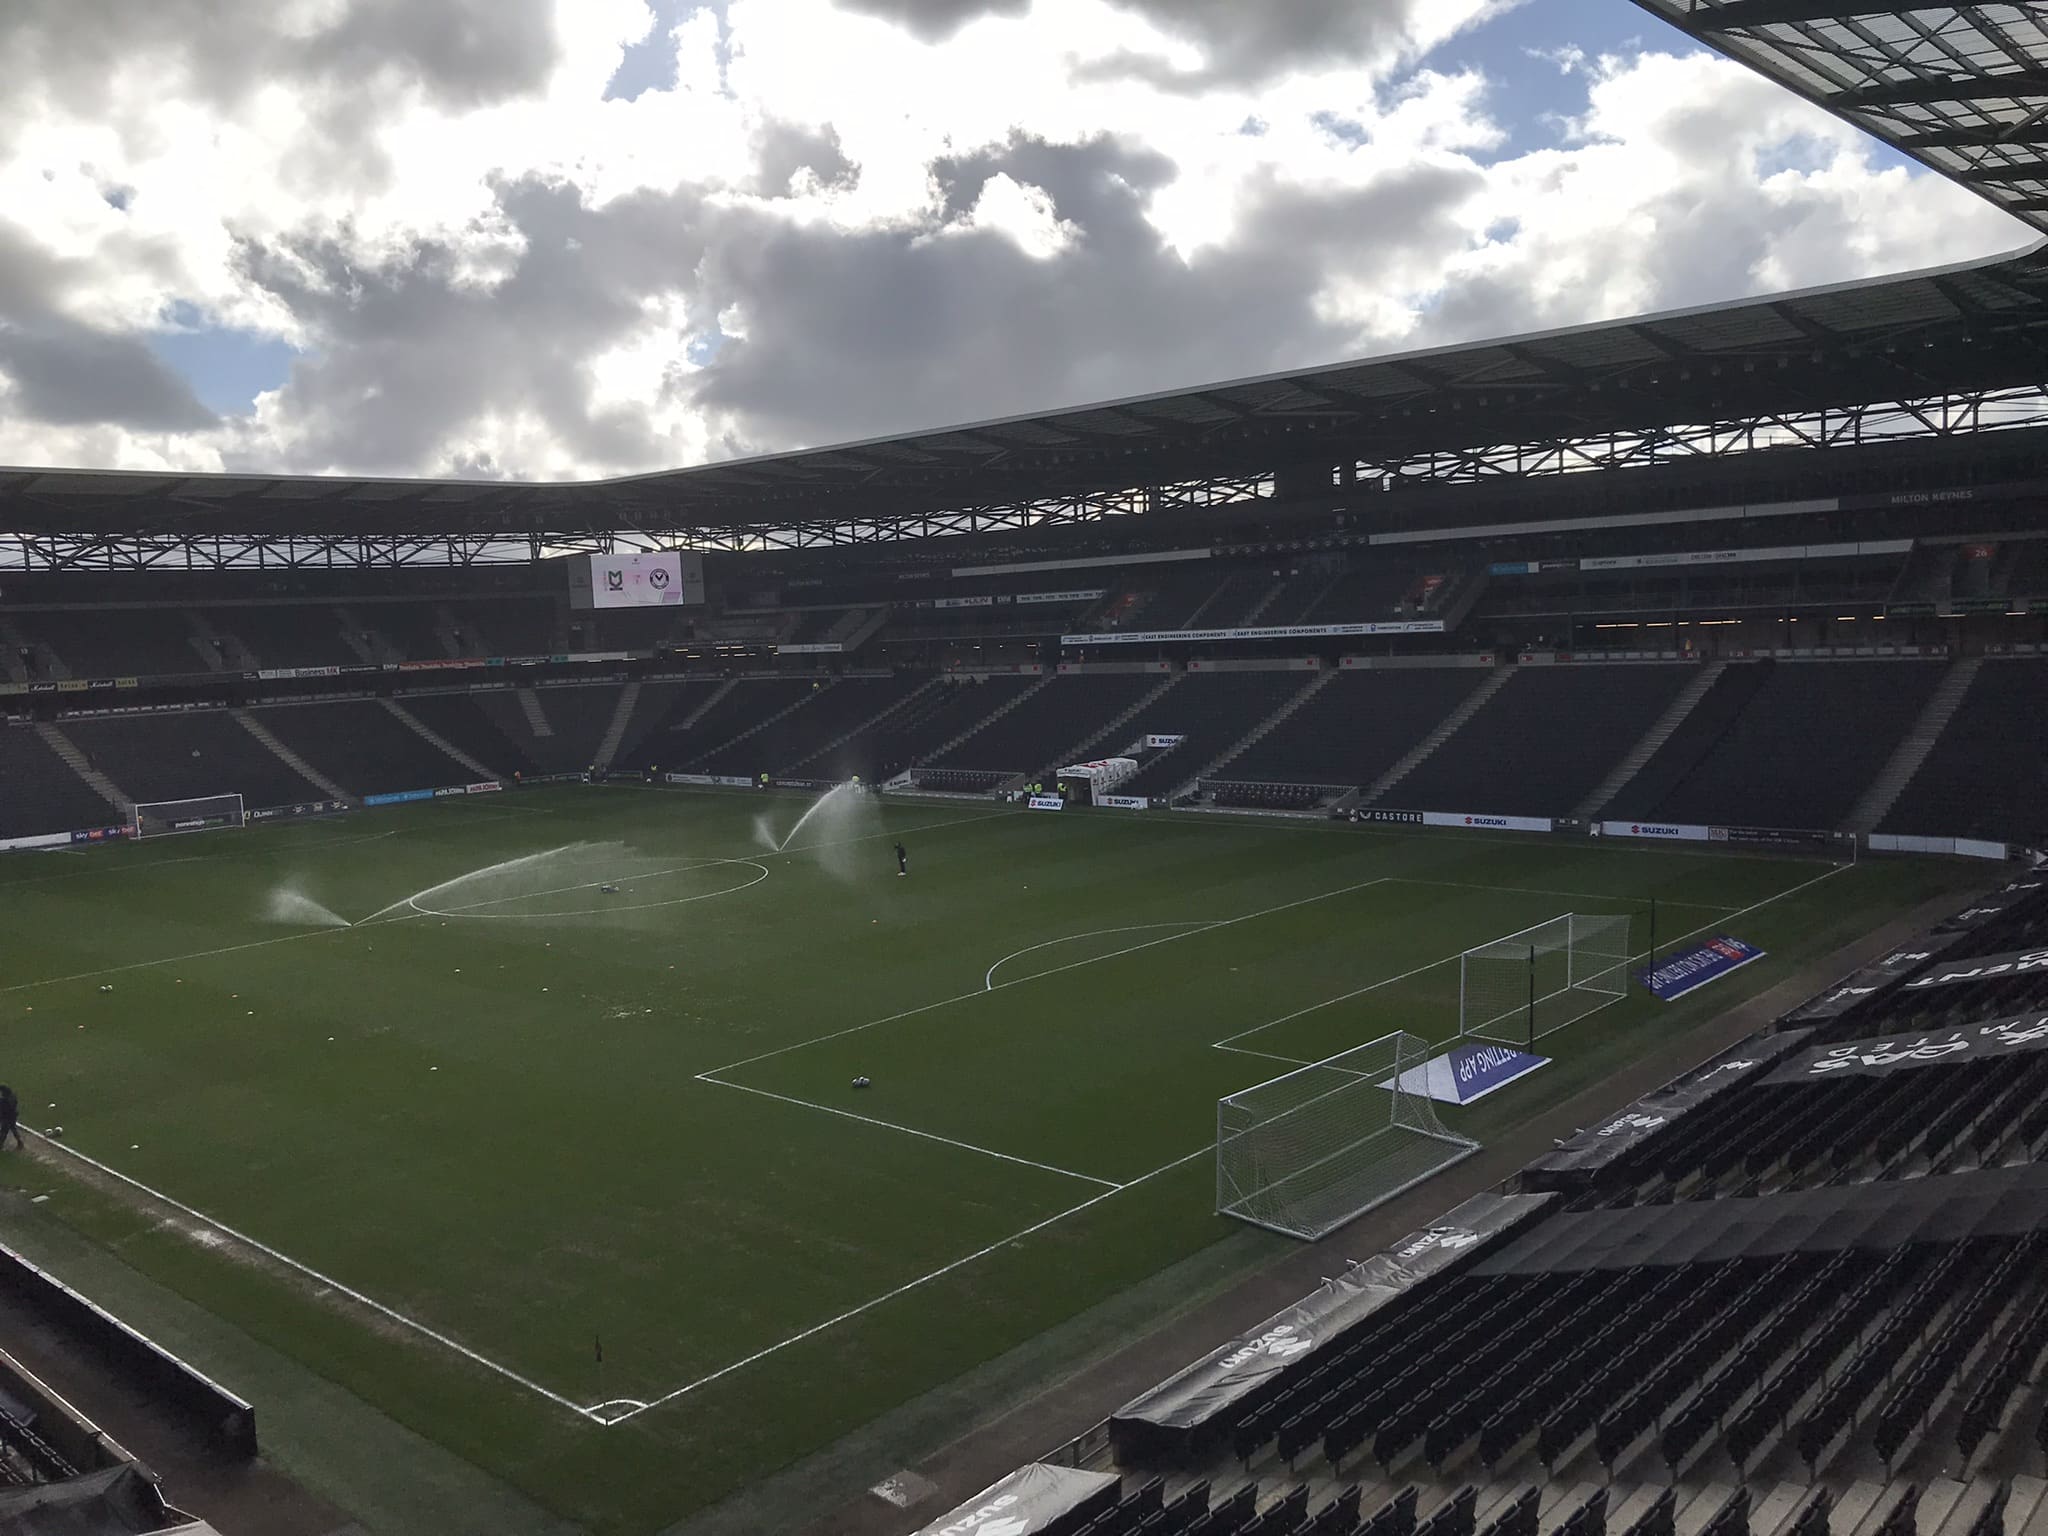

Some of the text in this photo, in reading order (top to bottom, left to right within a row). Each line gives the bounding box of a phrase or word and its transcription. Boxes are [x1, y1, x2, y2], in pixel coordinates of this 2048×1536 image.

[1890, 490, 1974, 505] MILTON KEYNES
[295, 668, 327, 679] Business
[1374, 811, 1423, 823] CASTORE
[1474, 817, 1506, 826] SUZUKI
[1641, 826, 1679, 835] SUZUKI
[1459, 1055, 1477, 1082] APP
[1217, 1323, 1294, 1369] SUZUKI
